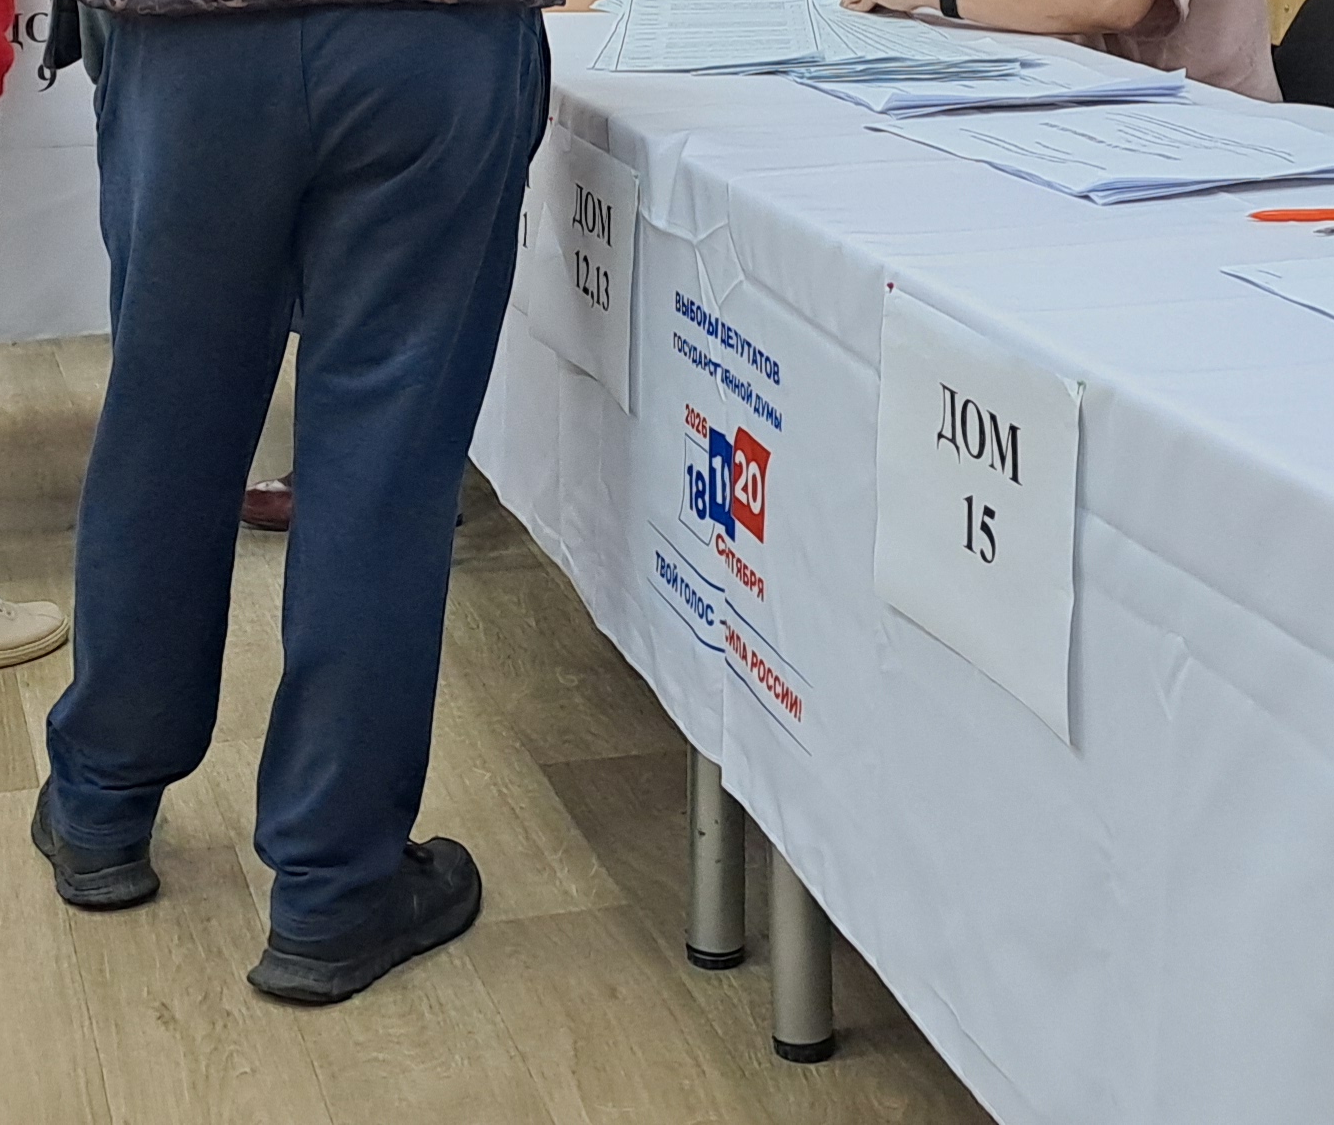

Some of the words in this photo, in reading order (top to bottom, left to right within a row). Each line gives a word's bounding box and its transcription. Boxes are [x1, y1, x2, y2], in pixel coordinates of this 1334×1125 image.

[10, 12, 49, 50] ДО
[37, 64, 57, 92] 9
[572, 182, 612, 247] ДОМ
[575, 250, 610, 311] 12,13
[685, 403, 708, 439] 2026
[753, 393, 782, 432] ДУМЫ
[937, 382, 1023, 486] ДОМ
[687, 463, 707, 520] 18
[735, 449, 762, 515] 20
[963, 495, 996, 563] 15
[655, 550, 678, 592] ТВОЙ
[680, 577, 714, 626] ГОЛОС
[750, 649, 802, 723] РОССИИ!
